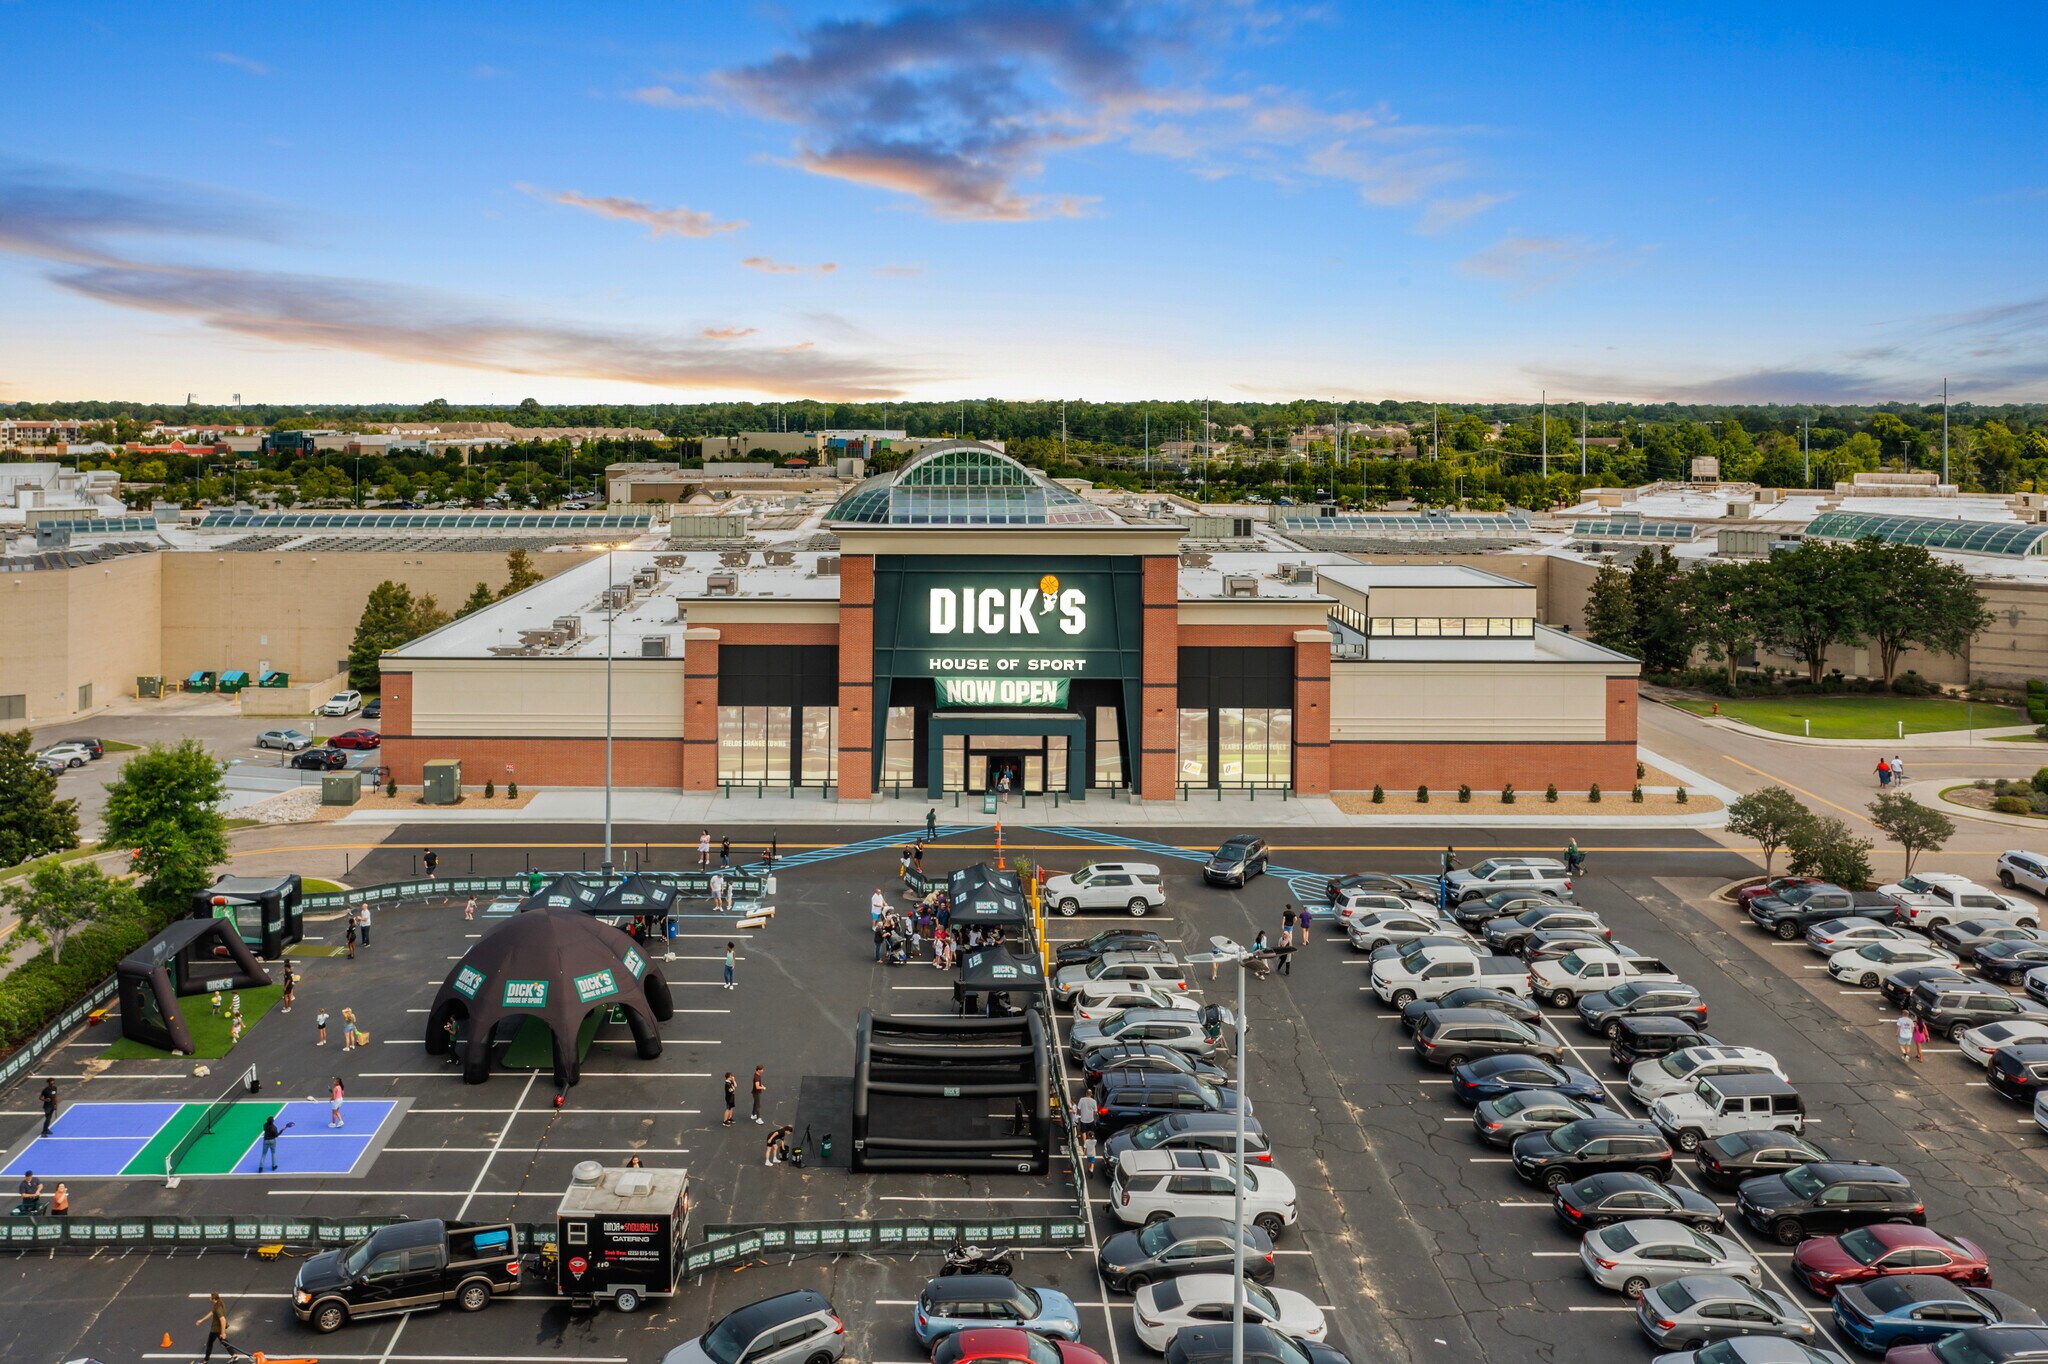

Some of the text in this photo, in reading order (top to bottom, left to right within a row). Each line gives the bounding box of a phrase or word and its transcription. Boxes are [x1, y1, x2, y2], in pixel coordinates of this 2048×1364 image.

[930, 575, 1086, 635] DICK'S
[929, 658, 1087, 671] HOUSE OF SPORT
[946, 679, 1058, 704] NOW OPEN
[976, 901, 999, 910] DICK'S
[993, 965, 1018, 975] DICK'S
[459, 968, 483, 989] DICK'S
[577, 972, 612, 993] DICK'S
[207, 979, 232, 991] DICK'S
[507, 982, 545, 997] DICK'S
[624, 1222, 659, 1233] SNOWBALLS
[907, 1227, 929, 1237] DICK'S
[966, 1227, 988, 1237] DICK'S
[992, 1226, 1015, 1236] DICK'S
[1019, 1225, 1041, 1235] DICK'S
[1051, 1225, 1073, 1235] DICK'S
[795, 1231, 818, 1241] DICK'S
[822, 1229, 844, 1240] DICK'S
[849, 1229, 871, 1239] DICK'S
[880, 1228, 902, 1238] DICK'S
[612, 1235, 650, 1243] CATERING
